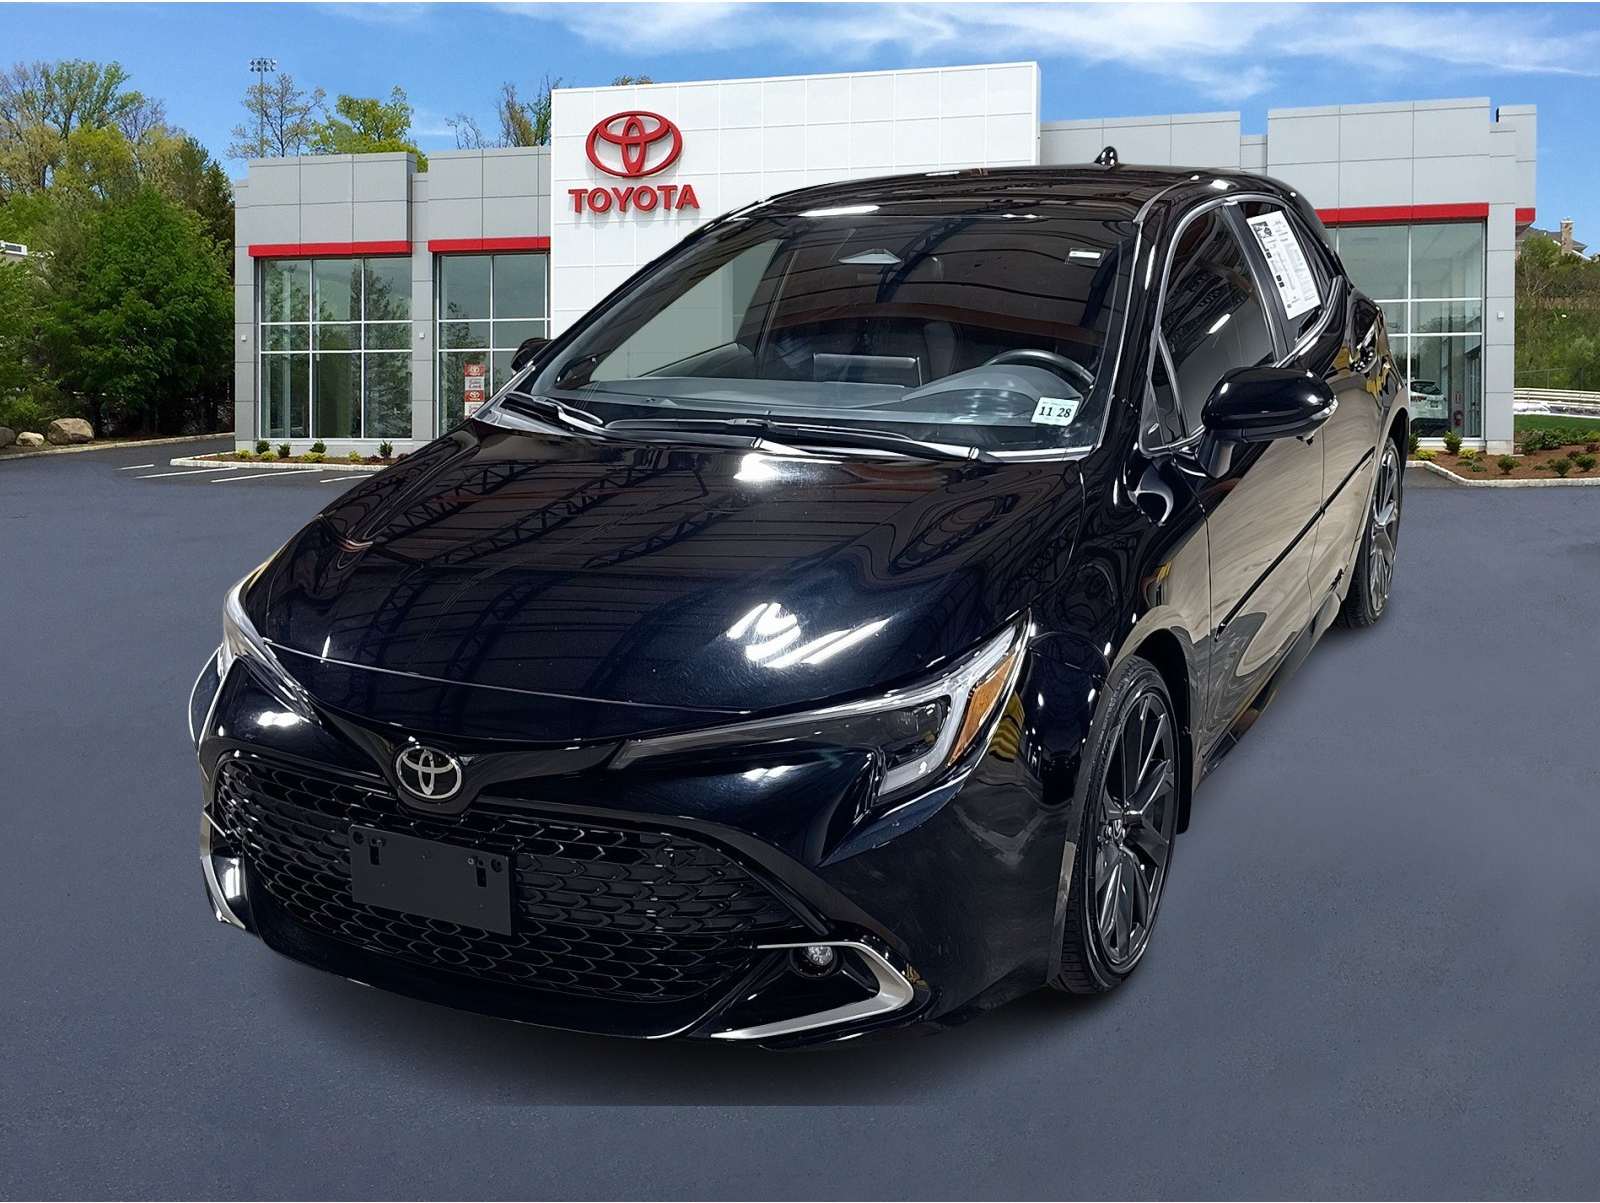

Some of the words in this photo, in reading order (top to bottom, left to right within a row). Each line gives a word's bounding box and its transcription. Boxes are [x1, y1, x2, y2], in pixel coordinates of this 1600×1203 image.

[568, 184, 700, 213] TOYOTA
[1038, 406, 1053, 417] 11
[1056, 407, 1072, 418] 28
